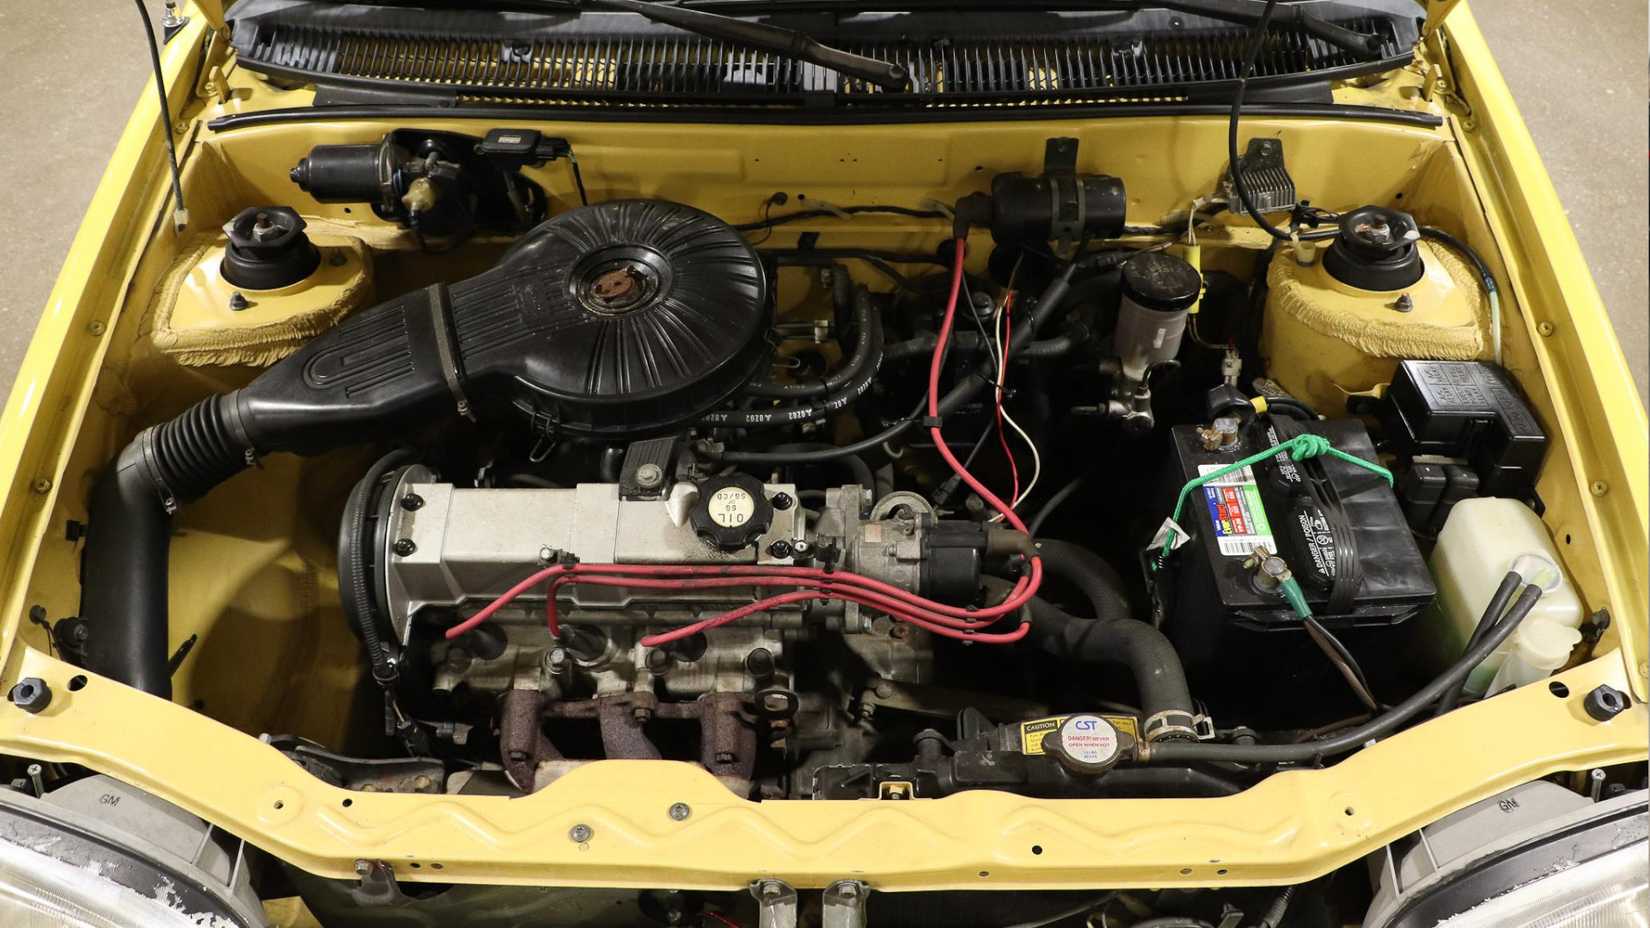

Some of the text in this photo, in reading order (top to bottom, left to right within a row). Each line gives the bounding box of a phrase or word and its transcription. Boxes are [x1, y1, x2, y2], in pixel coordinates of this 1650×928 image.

[718, 513, 744, 523] OIL
[1025, 721, 1056, 732] CAUTION
[1075, 720, 1098, 730] CST
[100, 793, 120, 806] GM
